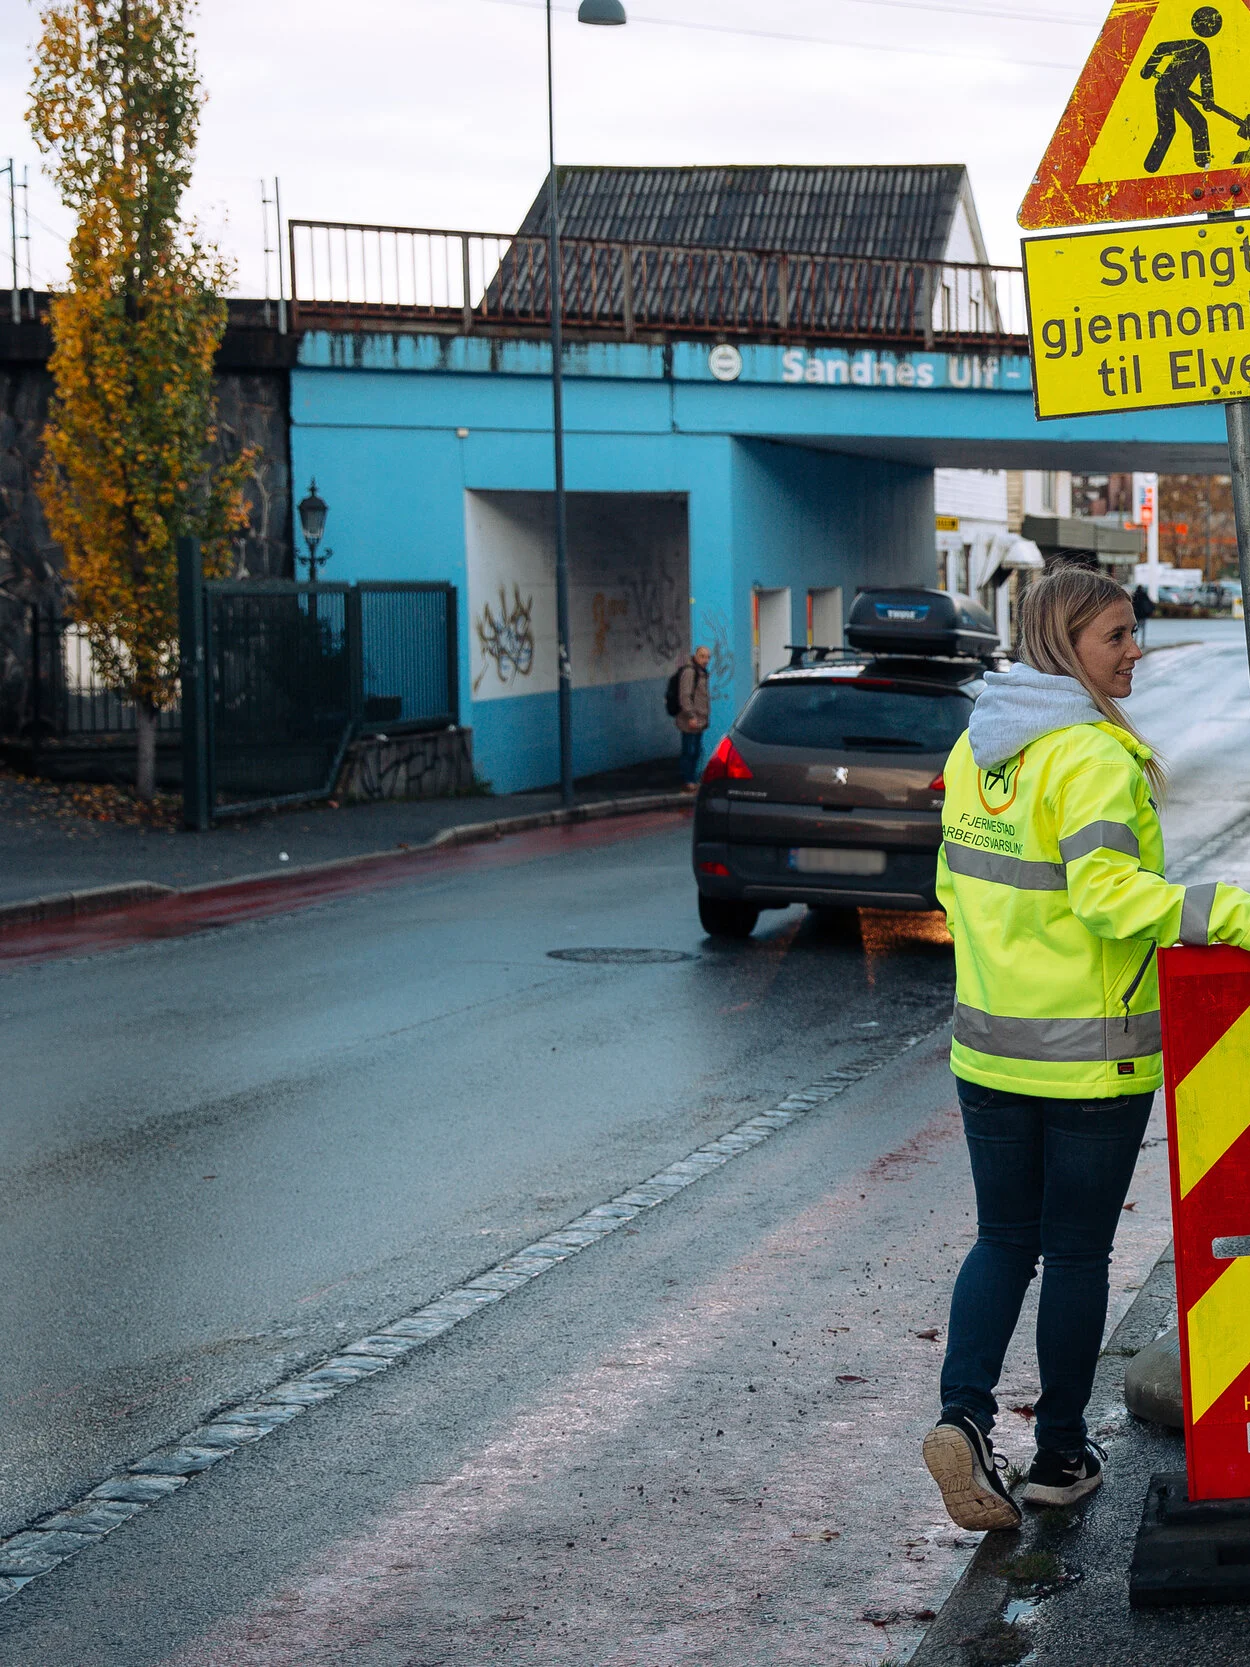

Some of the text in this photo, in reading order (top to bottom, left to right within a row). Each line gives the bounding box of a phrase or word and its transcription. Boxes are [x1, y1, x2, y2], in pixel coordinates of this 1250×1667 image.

[782, 350, 934, 387] Sandnes
[950, 355, 999, 389] Ulf
[1098, 349, 1143, 397] til
[959, 813, 1015, 837] FJERNESTAD
